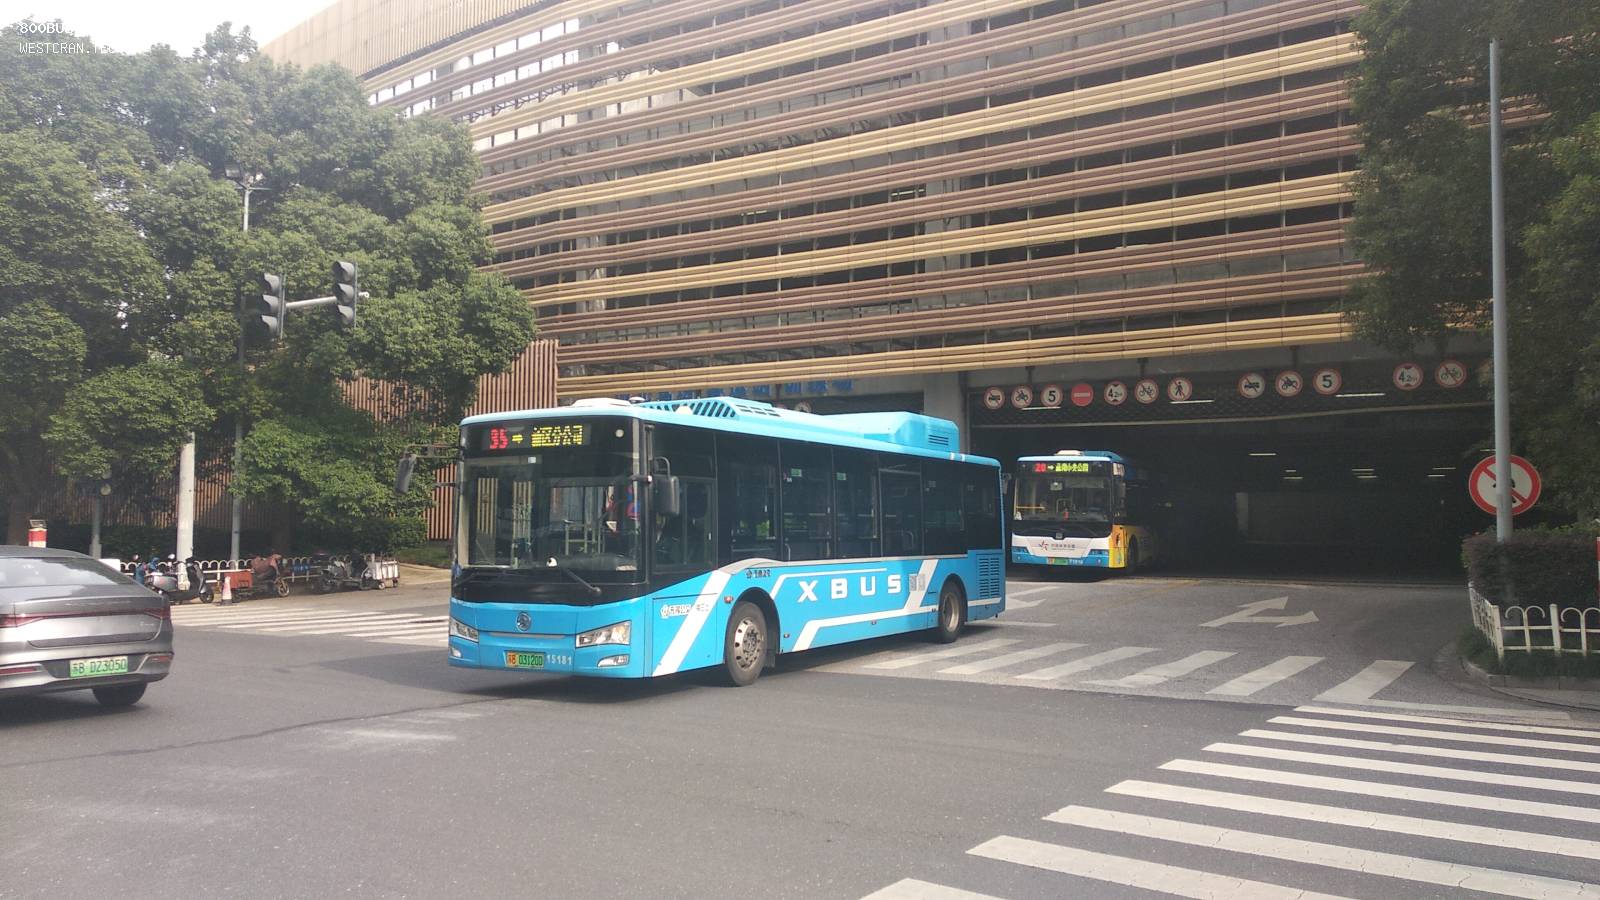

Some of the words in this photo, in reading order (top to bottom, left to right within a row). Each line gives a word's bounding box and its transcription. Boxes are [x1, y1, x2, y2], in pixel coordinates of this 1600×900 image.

[1322, 374, 1332, 389] 5
[1048, 390, 1056, 402] 5
[489, 427, 508, 449] 35
[797, 574, 902, 603] XBUS
[546, 654, 572, 665] 15181
